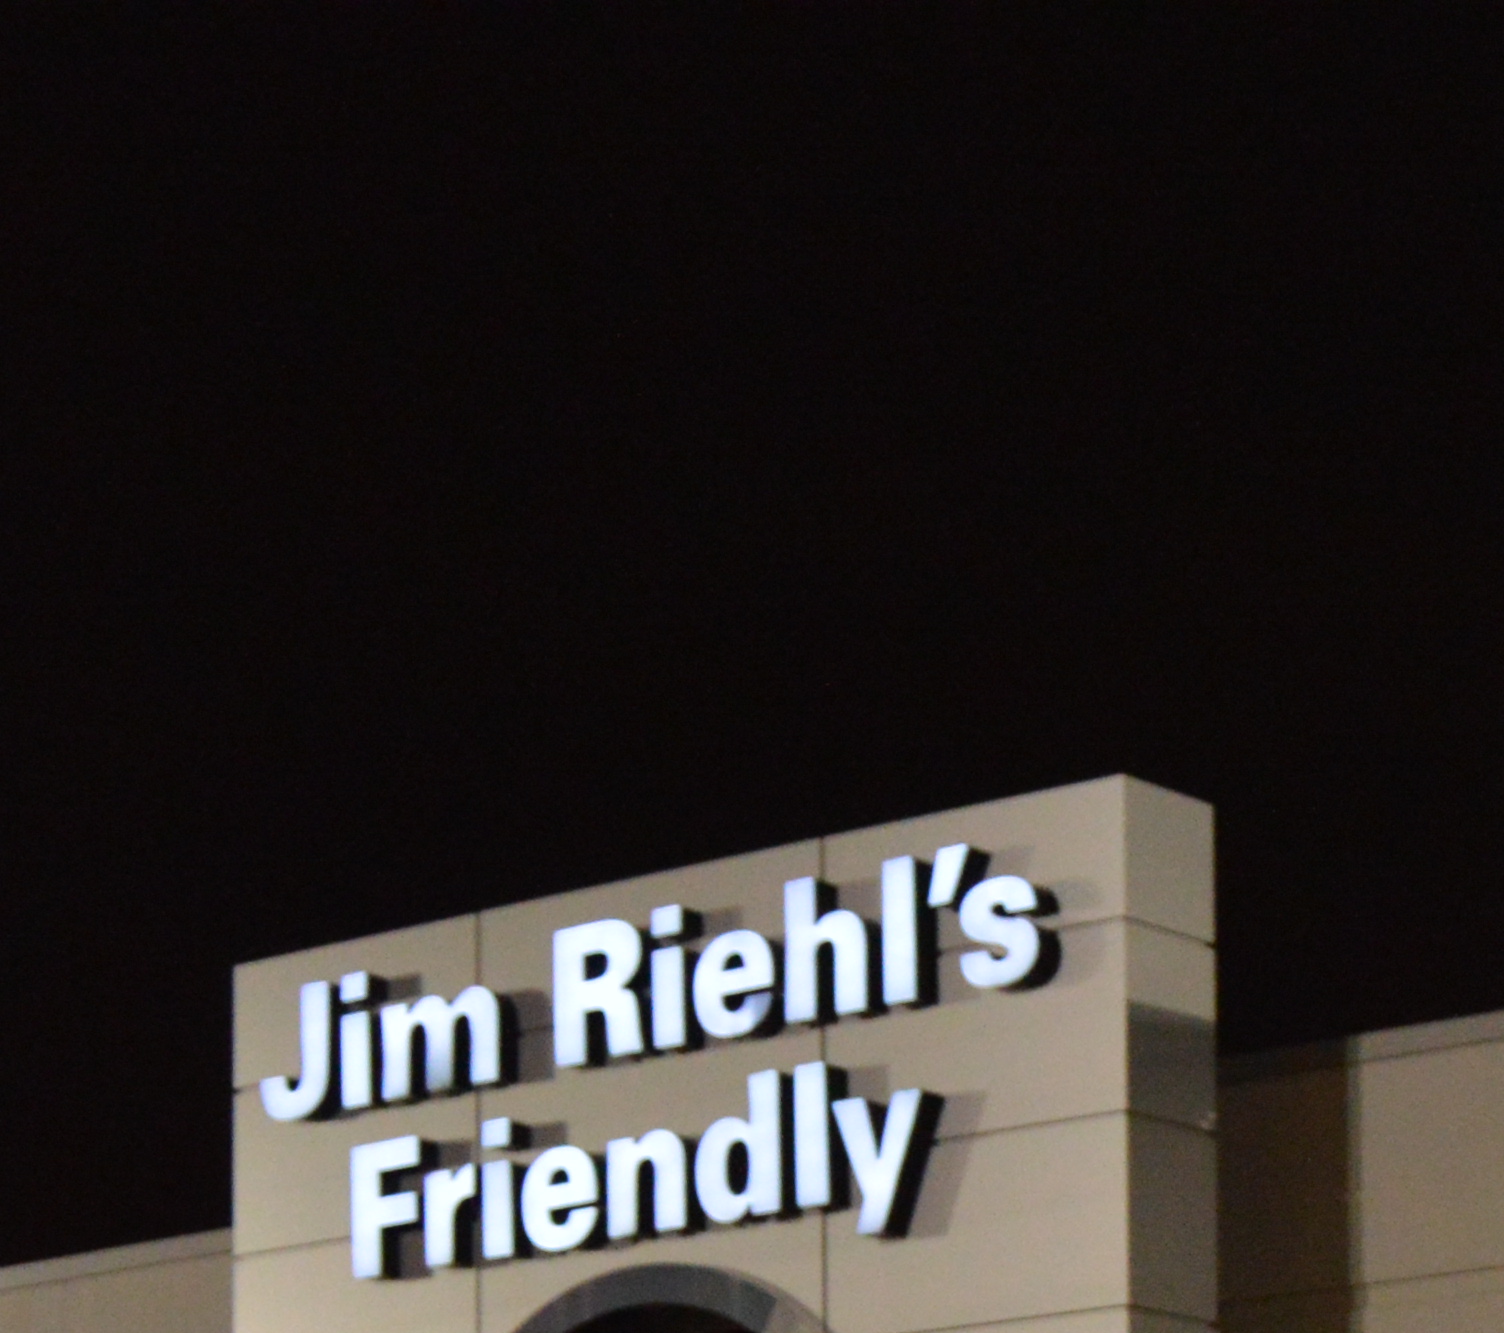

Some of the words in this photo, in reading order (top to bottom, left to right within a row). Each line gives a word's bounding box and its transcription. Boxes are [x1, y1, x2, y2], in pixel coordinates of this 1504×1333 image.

[259, 968, 501, 1122] Jim
[551, 842, 1038, 1068] Riehl's
[349, 1060, 924, 1280] Friendly
